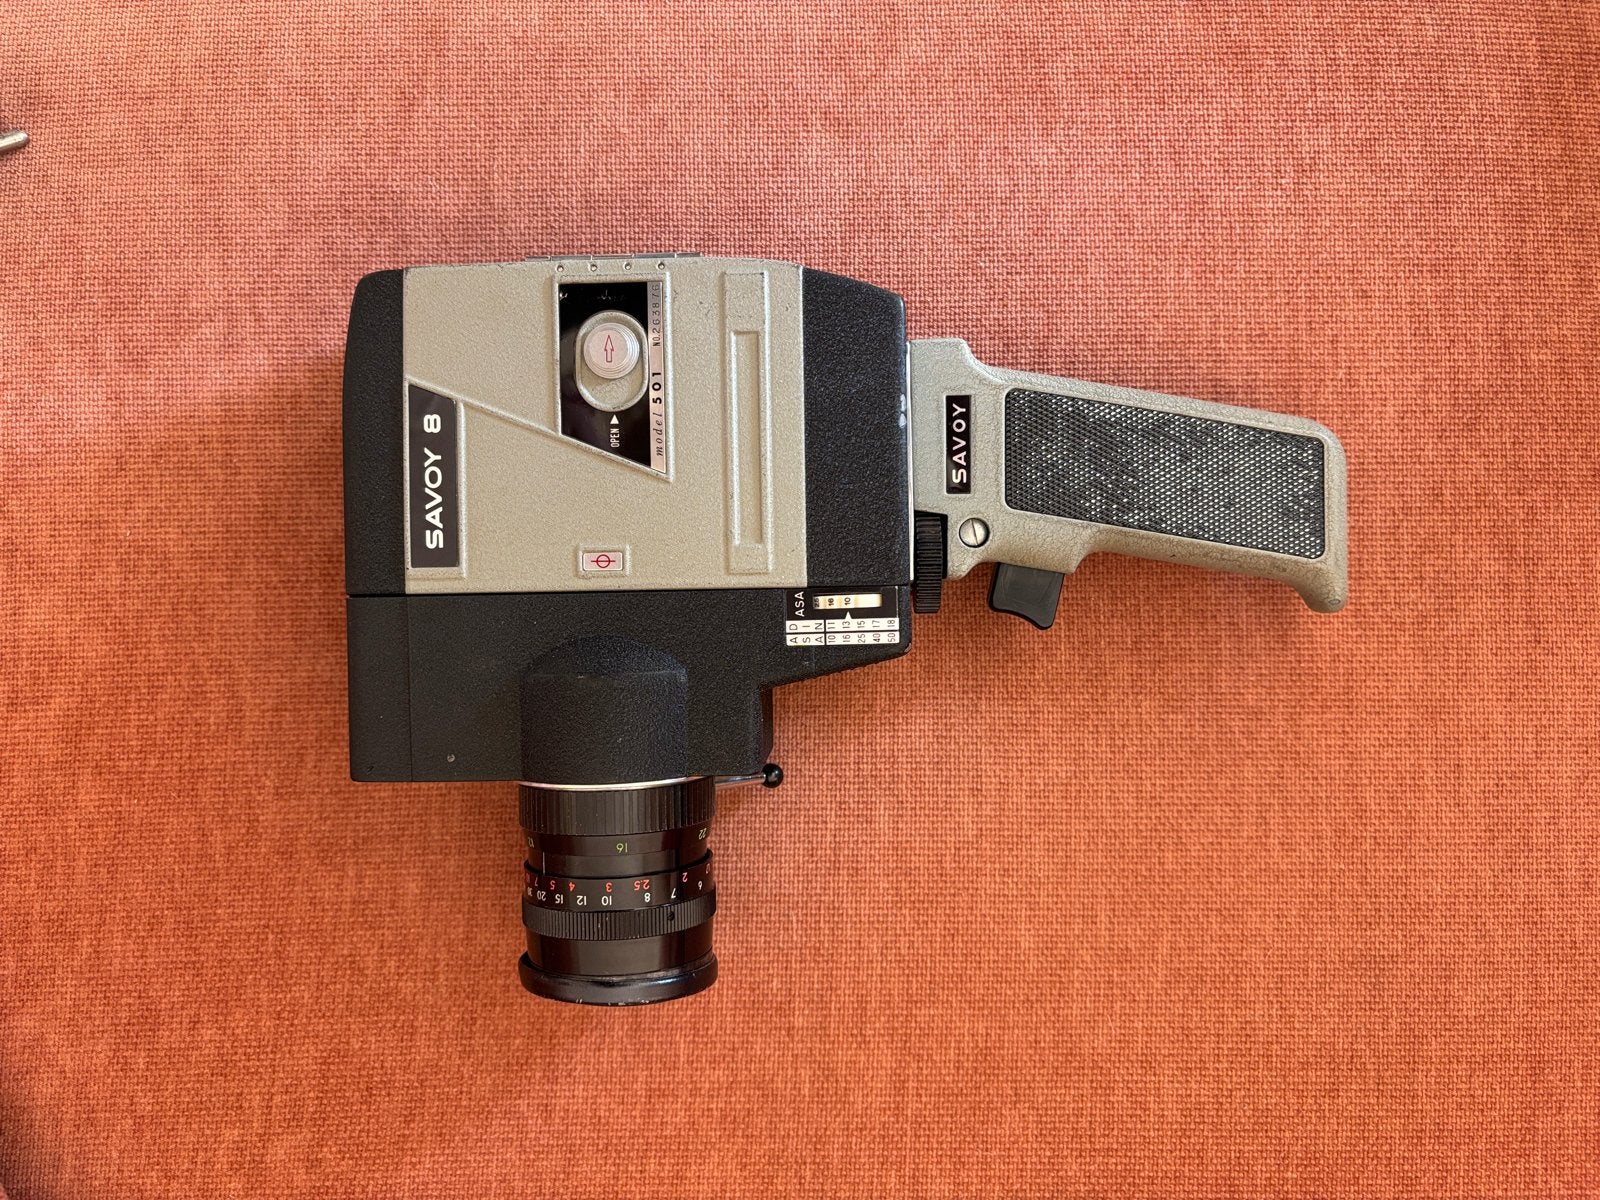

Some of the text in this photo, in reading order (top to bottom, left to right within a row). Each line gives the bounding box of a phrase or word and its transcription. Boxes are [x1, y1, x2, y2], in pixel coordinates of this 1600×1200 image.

[652, 372, 664, 456] model 501
[610, 428, 620, 448] OPEN
[953, 403, 967, 483] SAVOY
[423, 414, 444, 549] SAVOY 8
[795, 591, 804, 617] ASA
[844, 597, 851, 606] 10
[842, 620, 851, 629] 13
[856, 620, 866, 628] 15
[872, 620, 880, 628] 17
[887, 620, 896, 628] 18
[828, 632, 896, 644] 10 16 25 40 50
[698, 828, 707, 840] 22
[616, 842, 628, 854] 16
[682, 872, 688, 882] 2
[550, 880, 556, 890] 5
[568, 882, 576, 892] 4
[606, 882, 612, 892] 3
[634, 879, 650, 890] 2.5
[698, 880, 703, 890] 6
[536, 890, 546, 901] 20
[554, 894, 564, 904] 15
[644, 892, 650, 902] 8
[670, 888, 676, 899] 7
[576, 895, 587, 906] 12
[601, 895, 612, 906] 10
